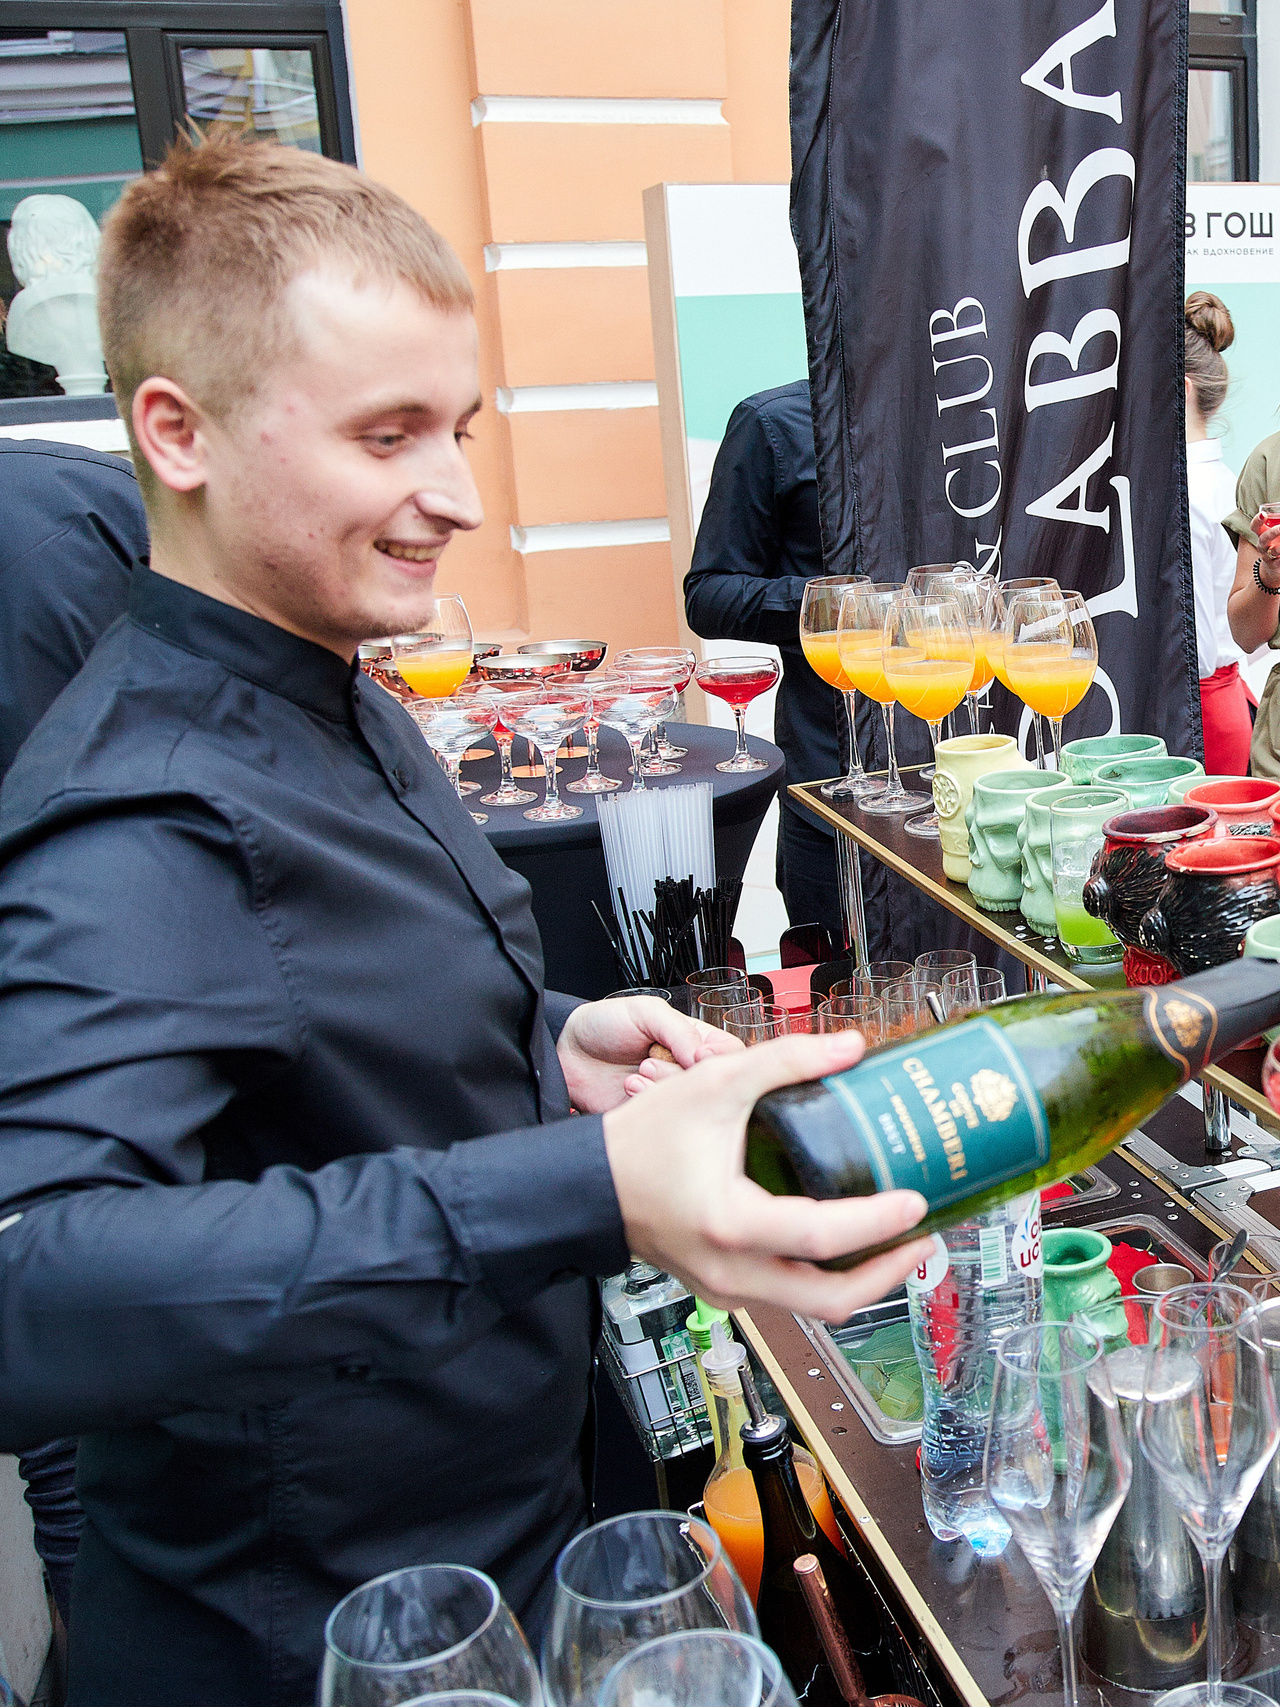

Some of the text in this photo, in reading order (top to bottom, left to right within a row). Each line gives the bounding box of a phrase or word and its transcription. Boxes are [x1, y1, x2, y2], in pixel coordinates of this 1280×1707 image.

[1206, 211, 1273, 238] ГОШ
[1203, 247, 1274, 256] ВДОХНОВЕНИЕ
[928, 296, 1003, 519] CLUB
[877, 1112, 906, 1155] BRUT
[902, 1057, 968, 1181] CHAMBERI
